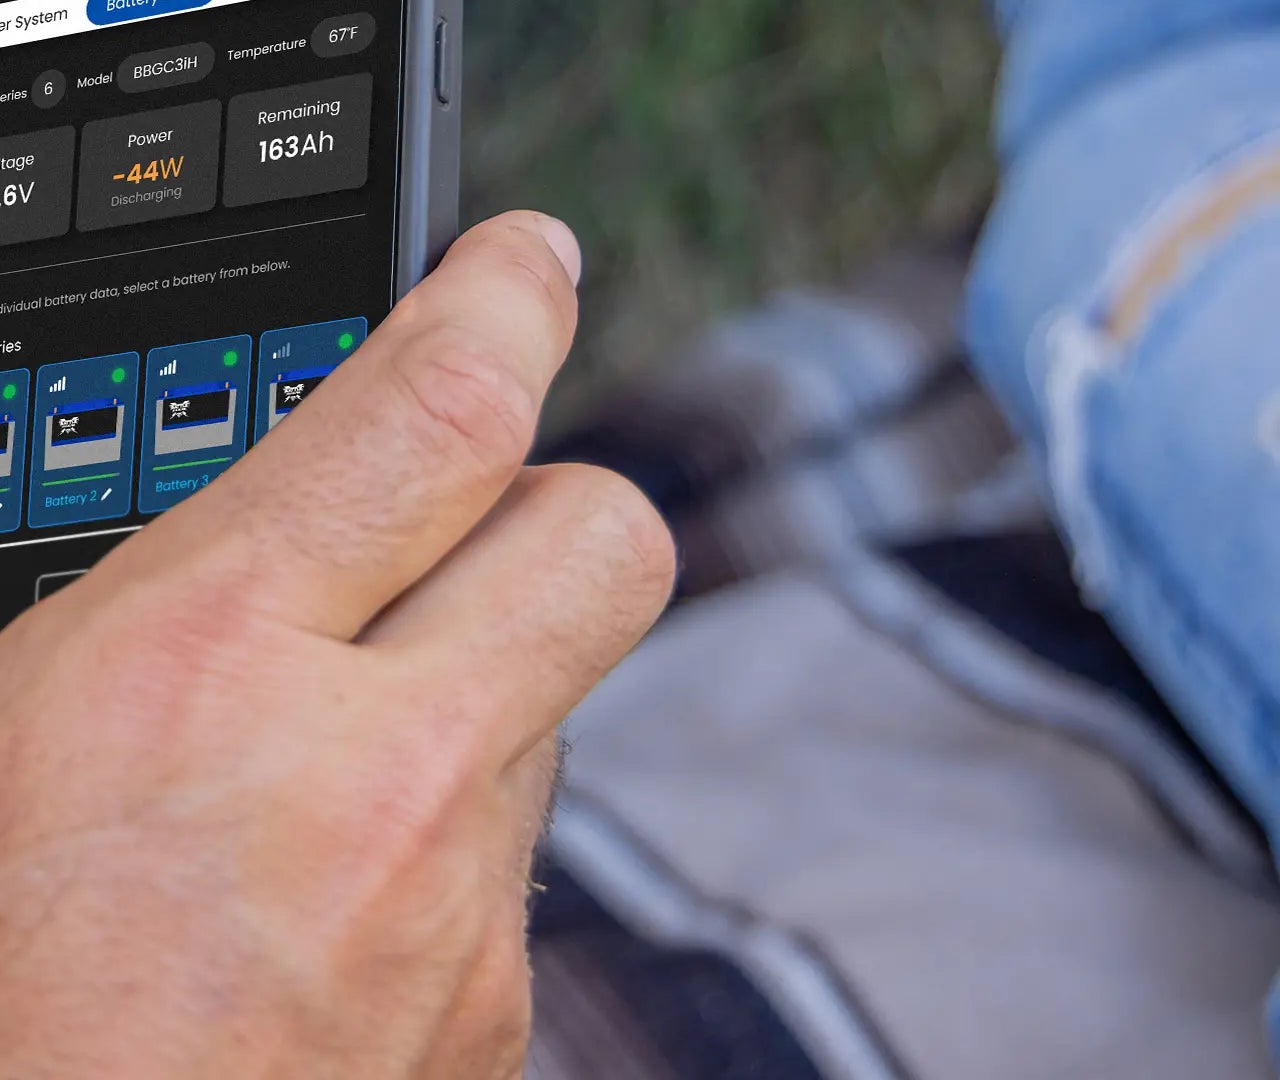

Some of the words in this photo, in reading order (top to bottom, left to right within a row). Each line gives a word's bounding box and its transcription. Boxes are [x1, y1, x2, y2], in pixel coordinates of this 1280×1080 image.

[15, 9, 68, 31] System
[328, 26, 359, 43] 67°F
[227, 36, 307, 61] Temperature
[133, 55, 198, 79] BBGC3iH
[44, 81, 53, 95] 6
[76, 71, 113, 89] Model
[257, 100, 341, 125] Remaining
[127, 129, 174, 148] Power
[259, 130, 334, 163] 163Ah
[112, 155, 184, 185] -44W
[111, 186, 182, 207] Discharging
[44, 292, 87, 307] battery
[90, 287, 121, 300] data,
[123, 279, 159, 295] select
[161, 278, 170, 288] a
[172, 270, 216, 287] battery
[219, 266, 248, 280] from
[251, 259, 291, 274] below.
[155, 477, 198, 493] Battery
[201, 474, 209, 487] 3
[45, 492, 87, 508] Battery
[89, 490, 97, 502] 2
